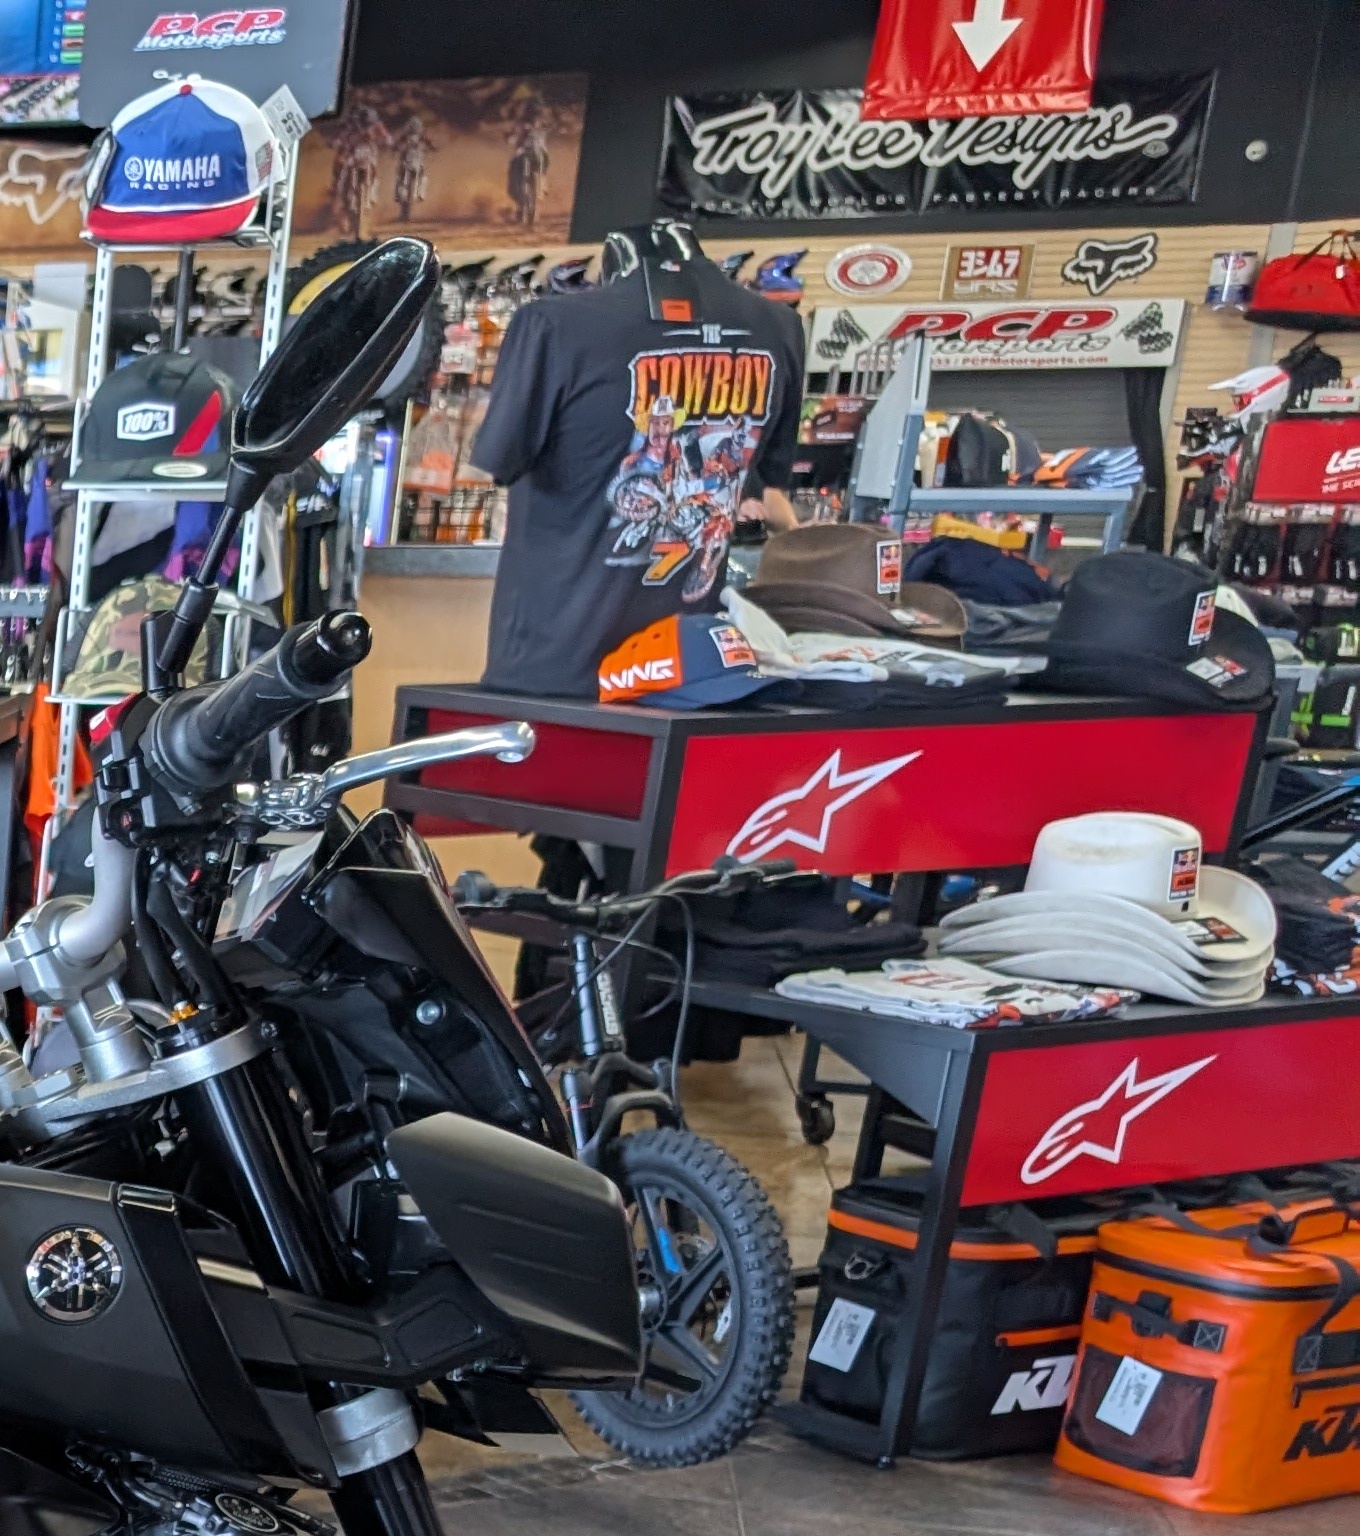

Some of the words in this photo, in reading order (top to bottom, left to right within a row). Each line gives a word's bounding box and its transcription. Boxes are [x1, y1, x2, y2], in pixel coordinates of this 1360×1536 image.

[147, 8, 285, 38] PCP
[134, 26, 286, 51] Motorsports
[144, 155, 221, 183] YAMAHA
[129, 180, 218, 190] RACING
[884, 308, 1120, 342] PCP
[634, 352, 770, 416] COWBOY
[122, 413, 170, 432] 100%
[643, 541, 693, 584] 7
[990, 1354, 1078, 1416] KT
